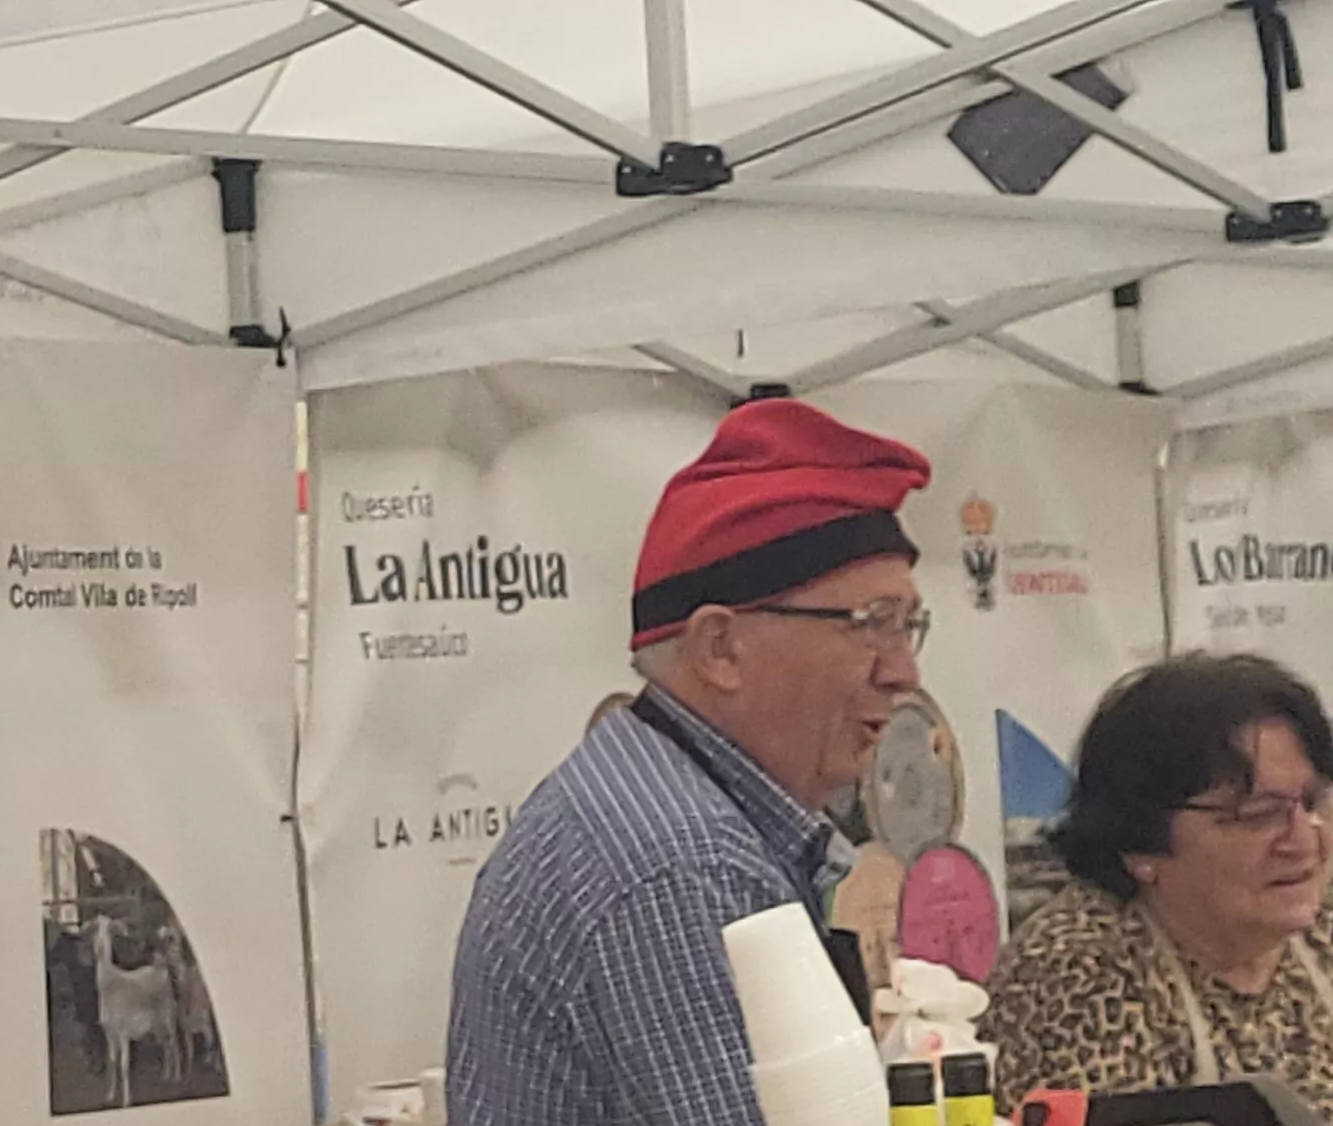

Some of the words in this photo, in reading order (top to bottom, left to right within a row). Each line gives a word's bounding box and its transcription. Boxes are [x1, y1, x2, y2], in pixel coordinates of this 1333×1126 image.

[343, 545, 407, 606] La
[413, 536, 568, 614] Antigua
[373, 815, 413, 850] LA
